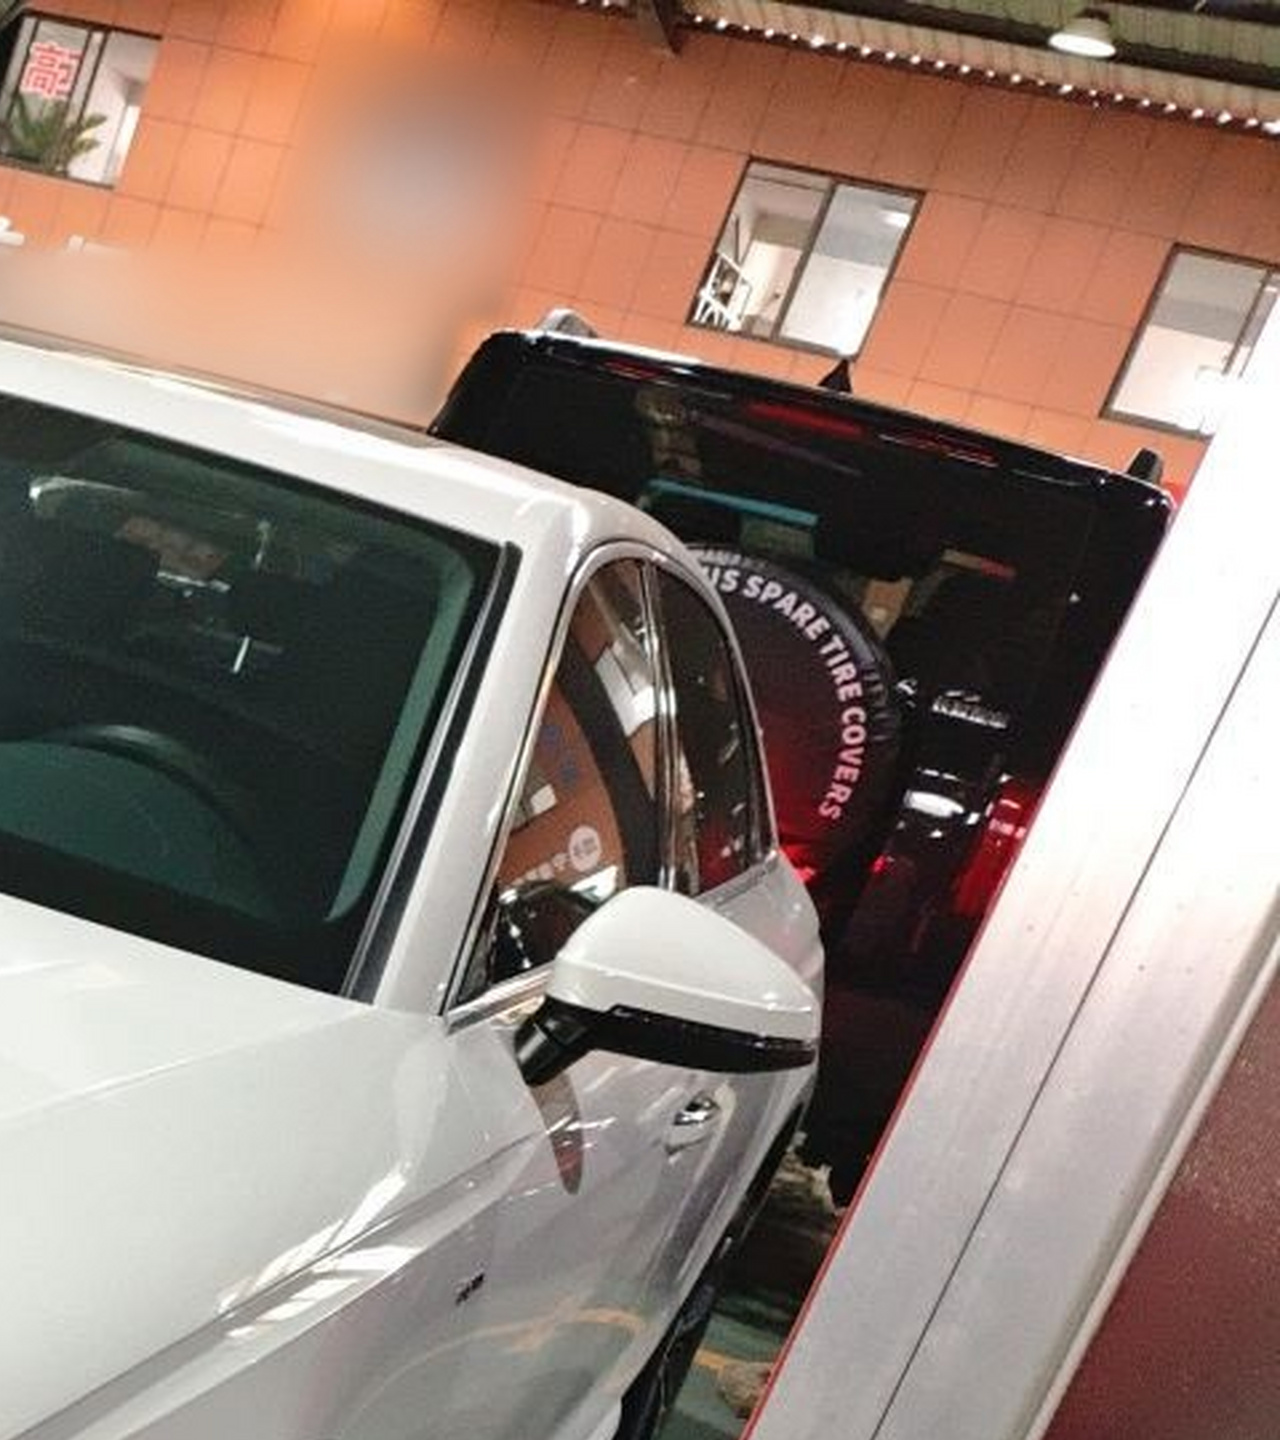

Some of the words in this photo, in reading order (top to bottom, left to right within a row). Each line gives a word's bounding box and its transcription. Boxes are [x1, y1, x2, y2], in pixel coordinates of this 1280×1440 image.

[743, 575, 830, 640] SPARE
[819, 634, 862, 702] TIRE
[818, 706, 866, 820] COVERS
